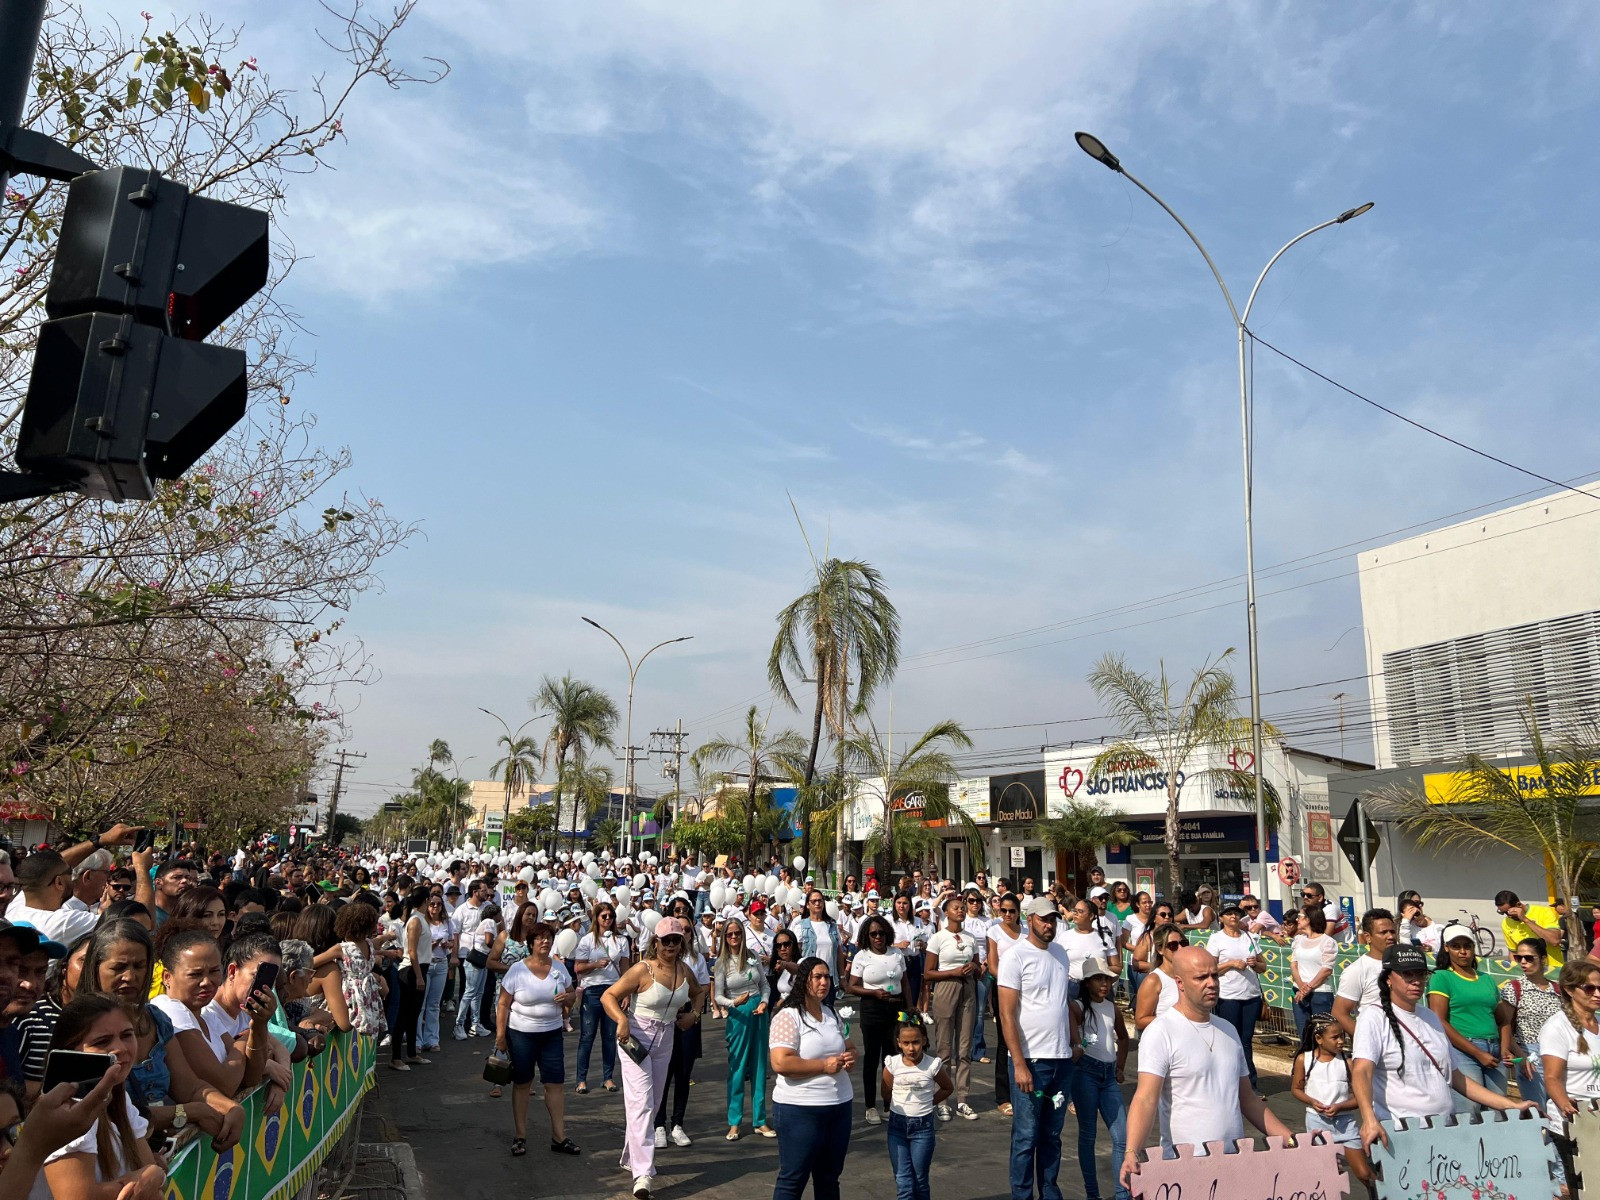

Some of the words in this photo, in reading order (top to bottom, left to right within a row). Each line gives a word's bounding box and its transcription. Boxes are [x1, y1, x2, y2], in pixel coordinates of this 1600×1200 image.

[1000, 810, 1014, 821] Doce
[1015, 809, 1033, 820] Madu
[1203, 831, 1225, 839] FAMÍLIA
[1398, 1158, 1411, 1190] é
[1427, 1144, 1462, 1186] tão
[1474, 1136, 1522, 1180] bom
